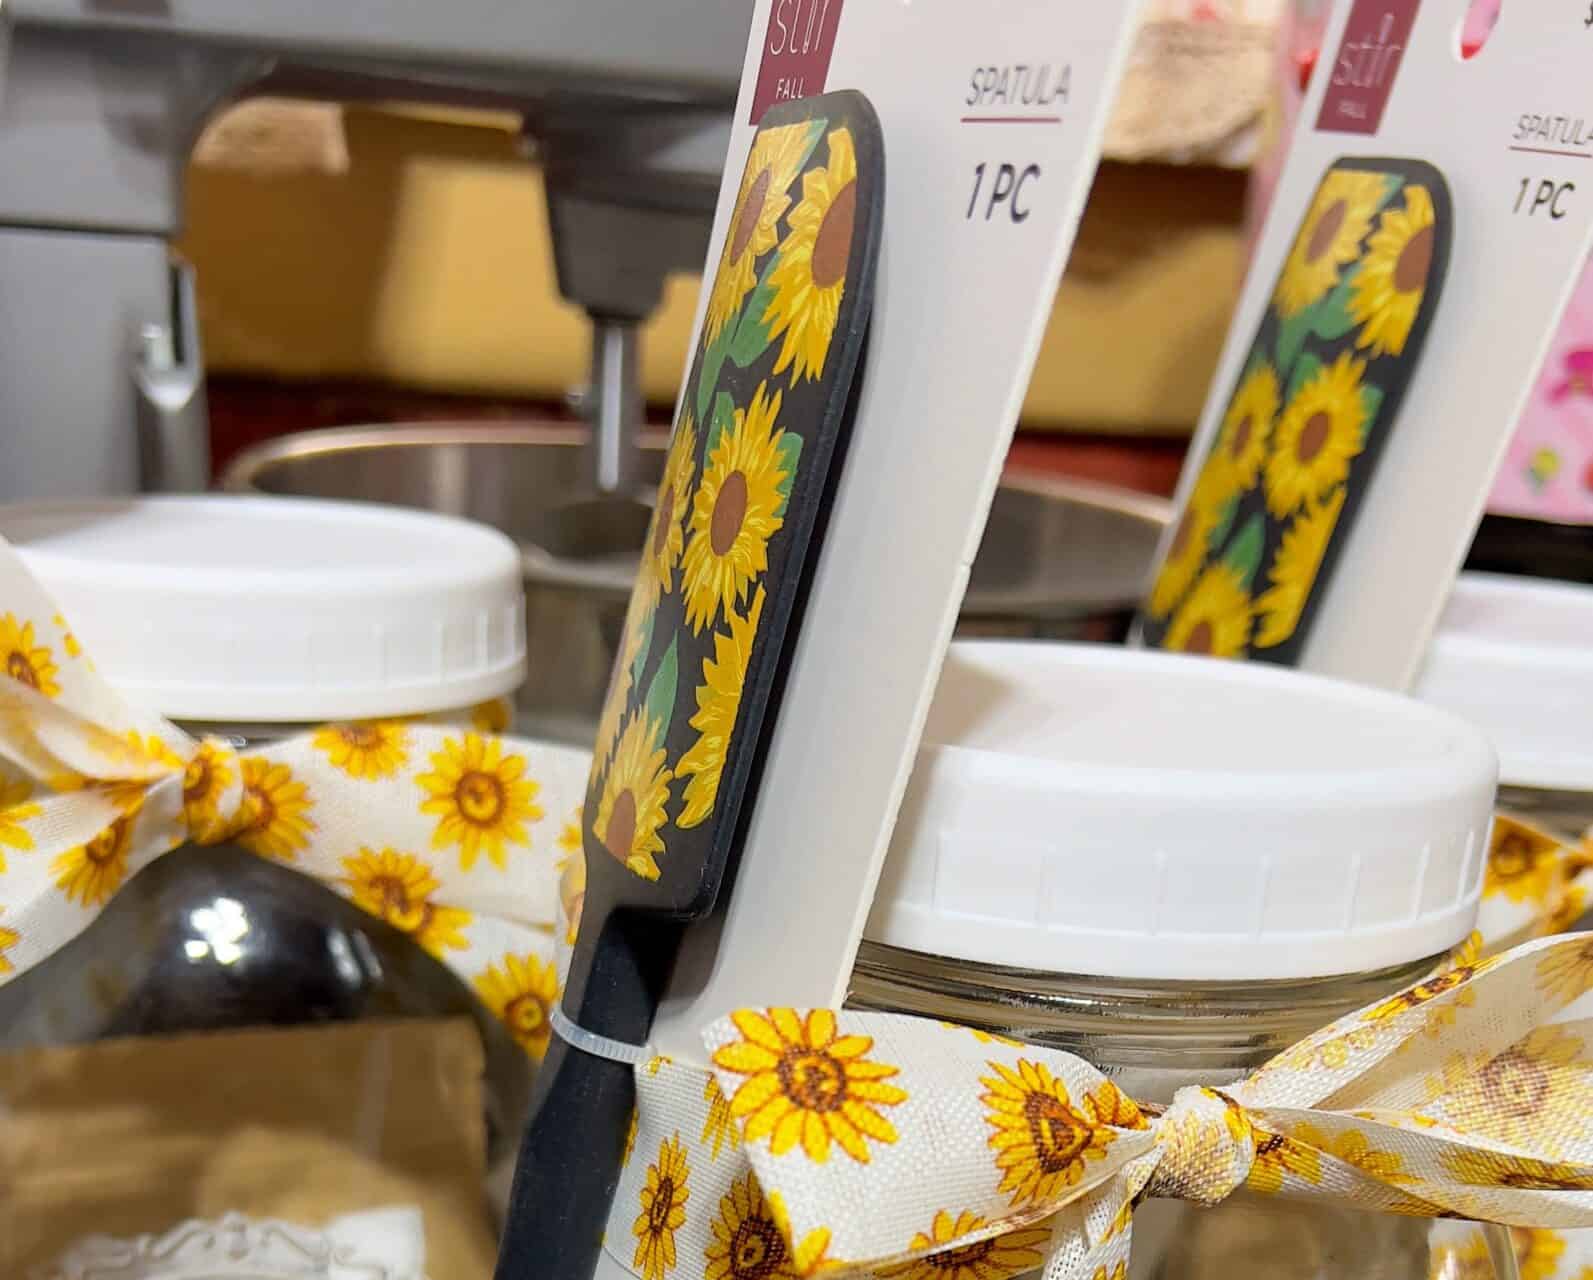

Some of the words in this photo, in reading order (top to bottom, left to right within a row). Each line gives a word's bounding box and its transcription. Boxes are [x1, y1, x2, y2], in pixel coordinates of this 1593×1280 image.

[776, 78, 804, 99] FALL
[965, 64, 1072, 106] SPATULA
[966, 162, 986, 220] 1
[985, 162, 1041, 223] PC
[1529, 179, 1575, 219] PC
